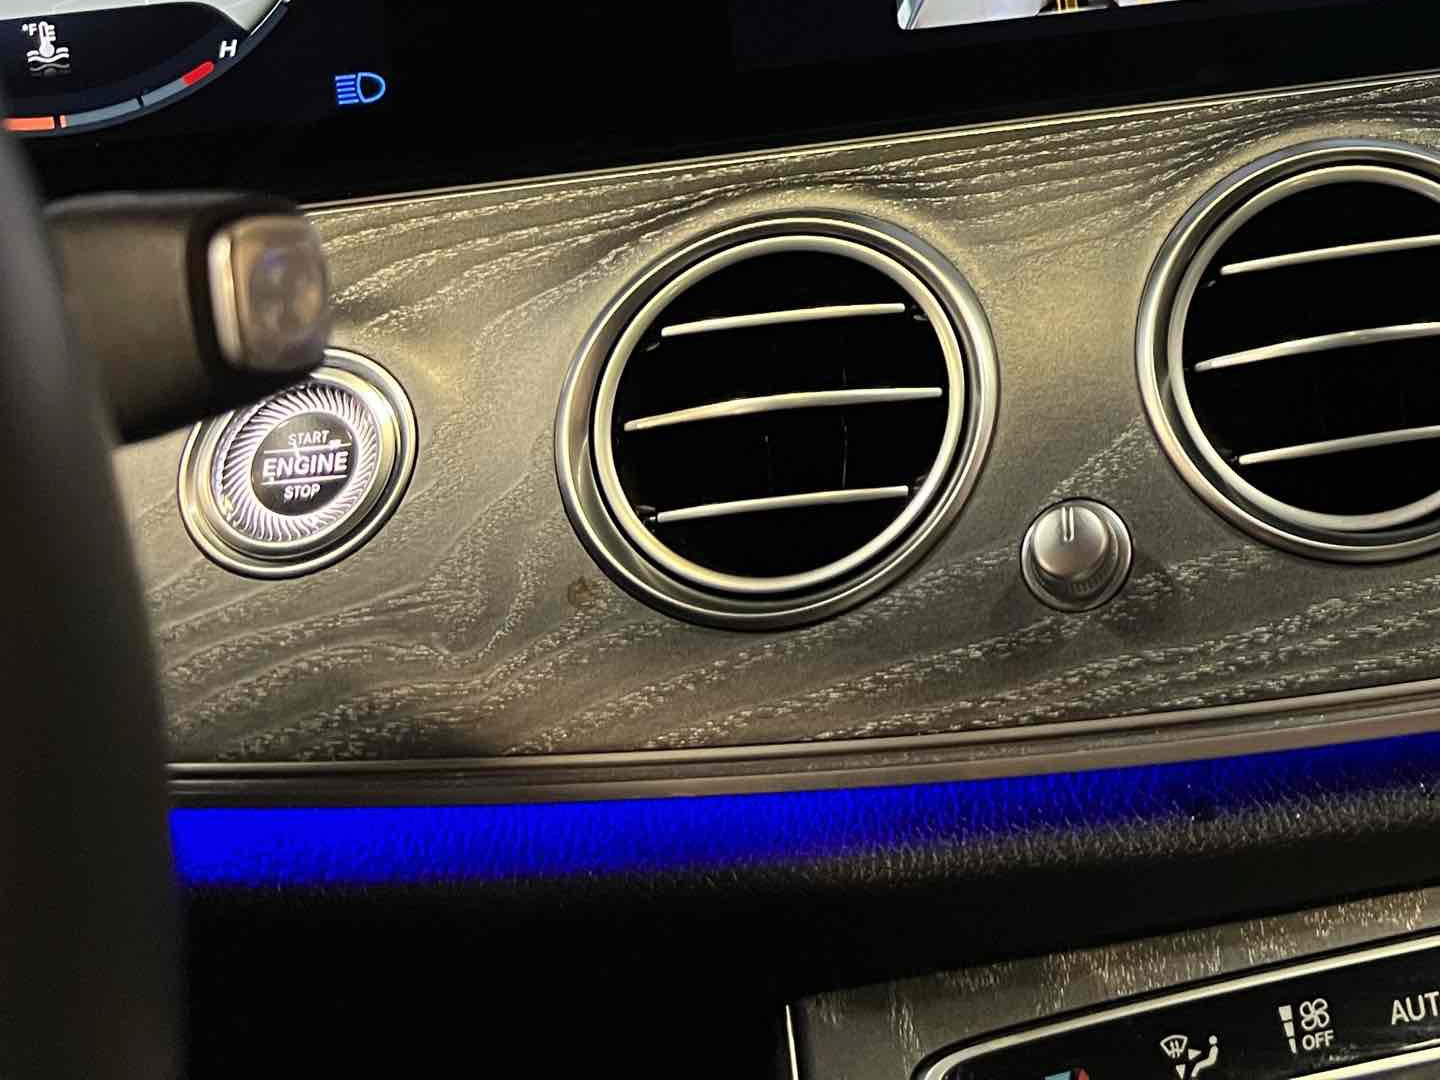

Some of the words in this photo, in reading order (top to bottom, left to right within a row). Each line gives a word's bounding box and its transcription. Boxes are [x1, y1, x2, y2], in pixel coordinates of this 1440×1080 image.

[219, 39, 238, 58] H
[287, 430, 331, 447] START
[262, 451, 349, 480] ENGINE
[283, 483, 321, 502] STOP
[1302, 1029, 1335, 1052] OFF
